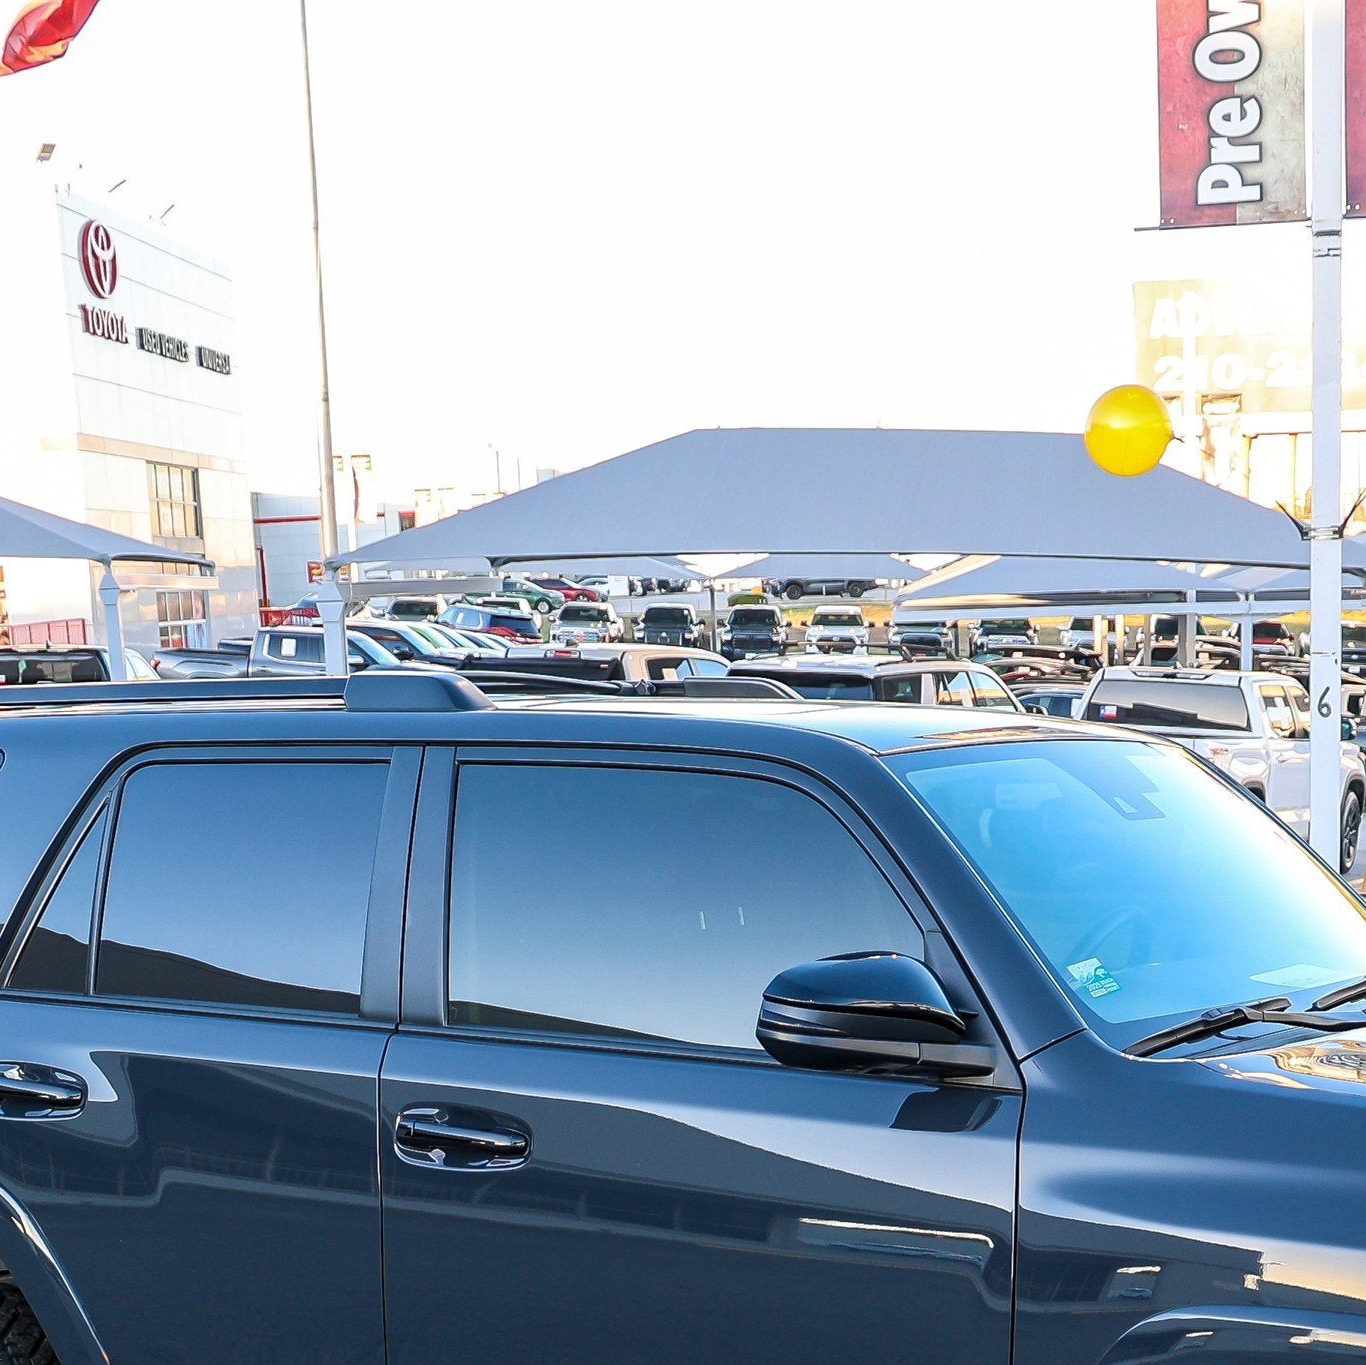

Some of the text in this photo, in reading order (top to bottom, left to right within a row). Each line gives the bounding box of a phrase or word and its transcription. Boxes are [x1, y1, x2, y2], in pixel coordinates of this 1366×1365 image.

[1195, 94, 1264, 207] Pre
[79, 303, 129, 344] TOYOTA
[197, 346, 232, 375] UNIVERSA
[1317, 685, 1332, 718] 6
